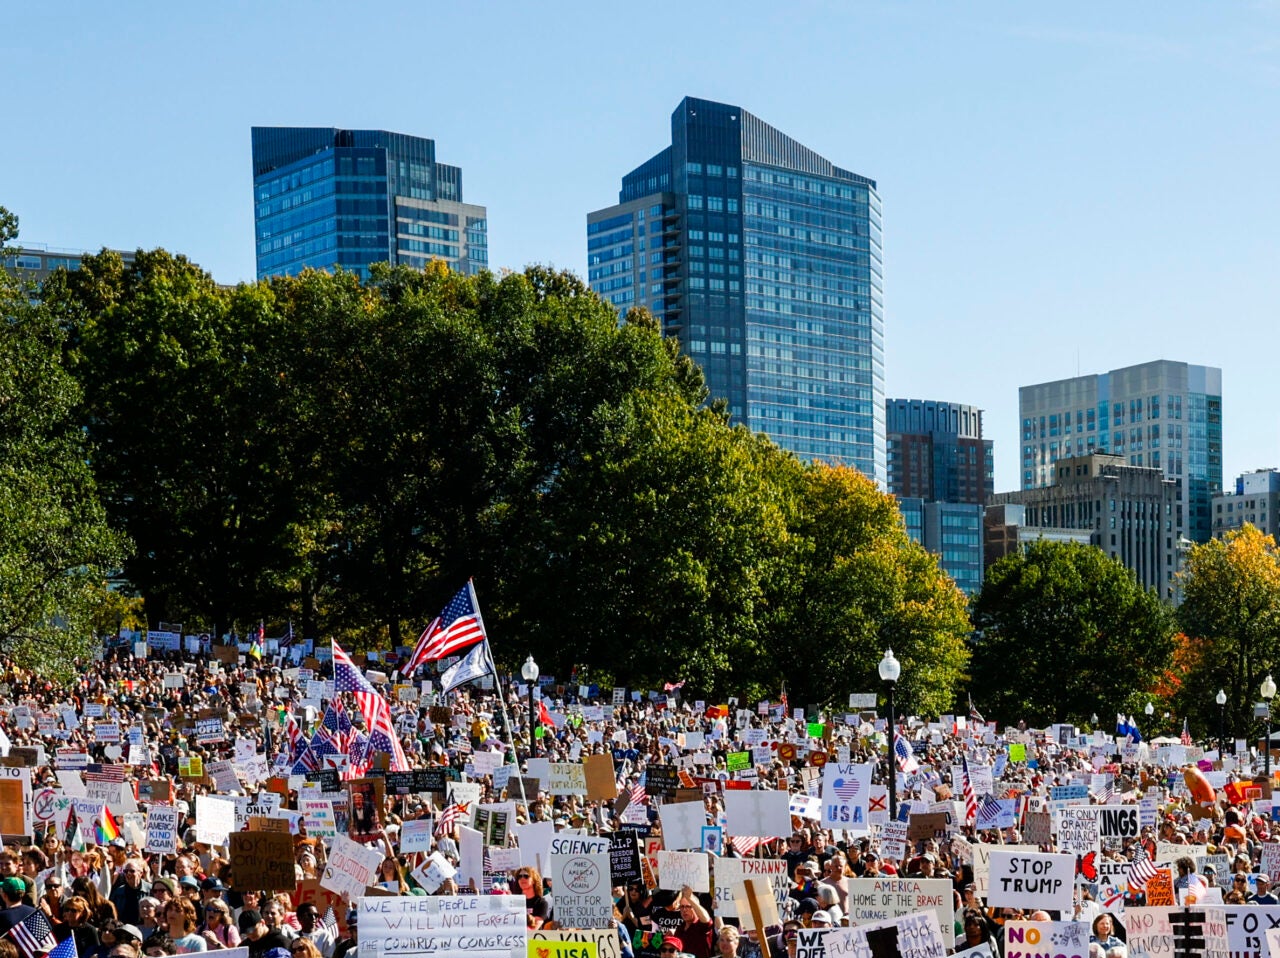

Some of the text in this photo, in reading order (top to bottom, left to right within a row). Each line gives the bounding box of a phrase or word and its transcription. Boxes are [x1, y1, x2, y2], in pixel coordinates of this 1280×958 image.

[838, 764, 855, 775] WE
[246, 805, 271, 815] ONLY
[828, 804, 863, 823] USA
[1060, 809, 1098, 820] THE ONLY
[150, 813, 175, 822] MAKE
[149, 823, 176, 831] AMERICA
[1061, 821, 1097, 831] ORANGE
[149, 832, 171, 840] KIND
[1058, 830, 1098, 842] MONARCH
[148, 840, 174, 849] AGAIN
[552, 839, 606, 854] SCIENCE
[1072, 842, 1093, 850] WANT
[741, 860, 788, 874] TYRANNY
[1009, 858, 1053, 875] STOP
[874, 881, 922, 893] AMERICA
[1000, 878, 1062, 894] TRUMP
[365, 899, 478, 912] WE THE PEOPLE
[555, 896, 601, 904] FIGHT FOR
[853, 894, 944, 906] HOME OF THE BRAVE
[576, 907, 597, 915] SOUL
[856, 909, 888, 920] COURAGE
[384, 912, 520, 930] WILL NOT FORGET
[1008, 927, 1041, 944] NO
[361, 940, 377, 950] THE
[441, 939, 451, 949] IN
[457, 936, 526, 950] CONGRESS
[1246, 937, 1260, 947] IS
